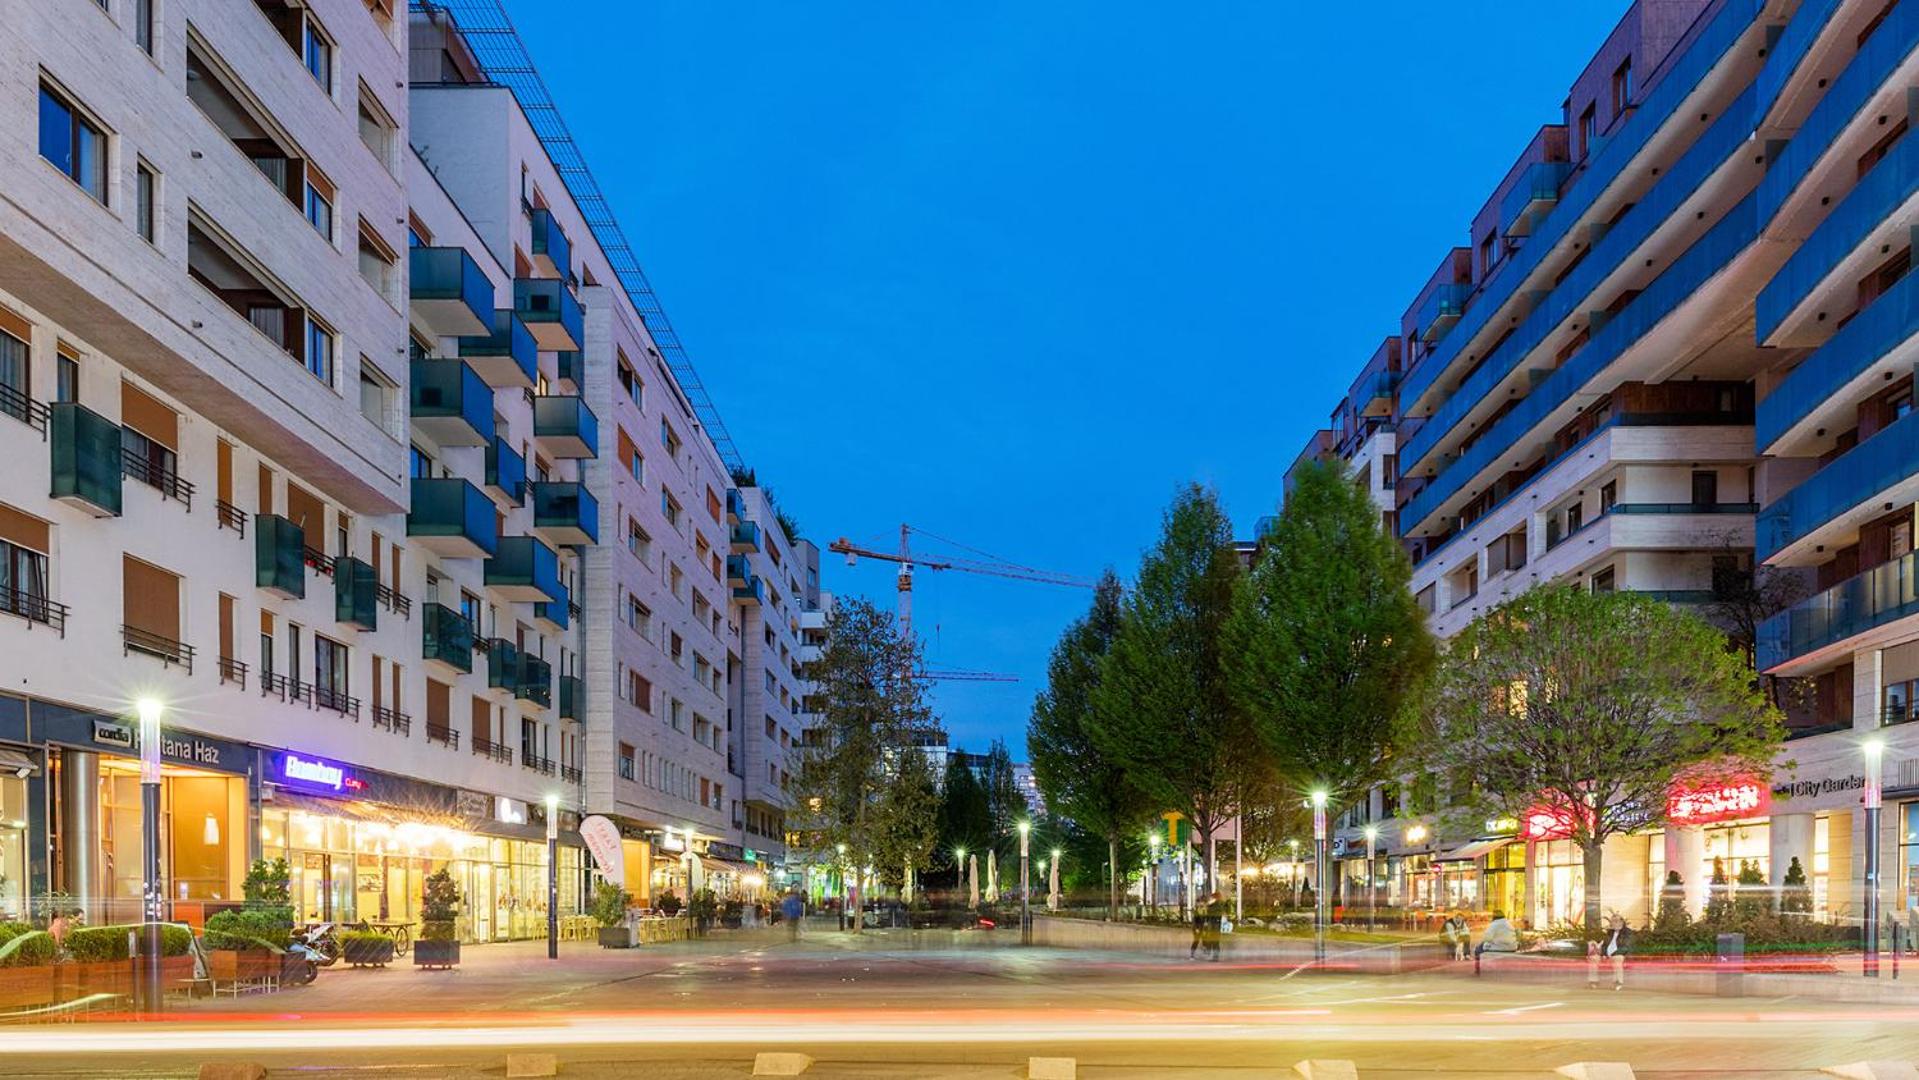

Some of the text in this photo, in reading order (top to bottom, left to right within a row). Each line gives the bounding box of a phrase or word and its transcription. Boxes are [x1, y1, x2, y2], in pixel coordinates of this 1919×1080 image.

[99, 727, 129, 742] cordia
[133, 728, 191, 760] Ftana
[1796, 780, 1820, 797] City
